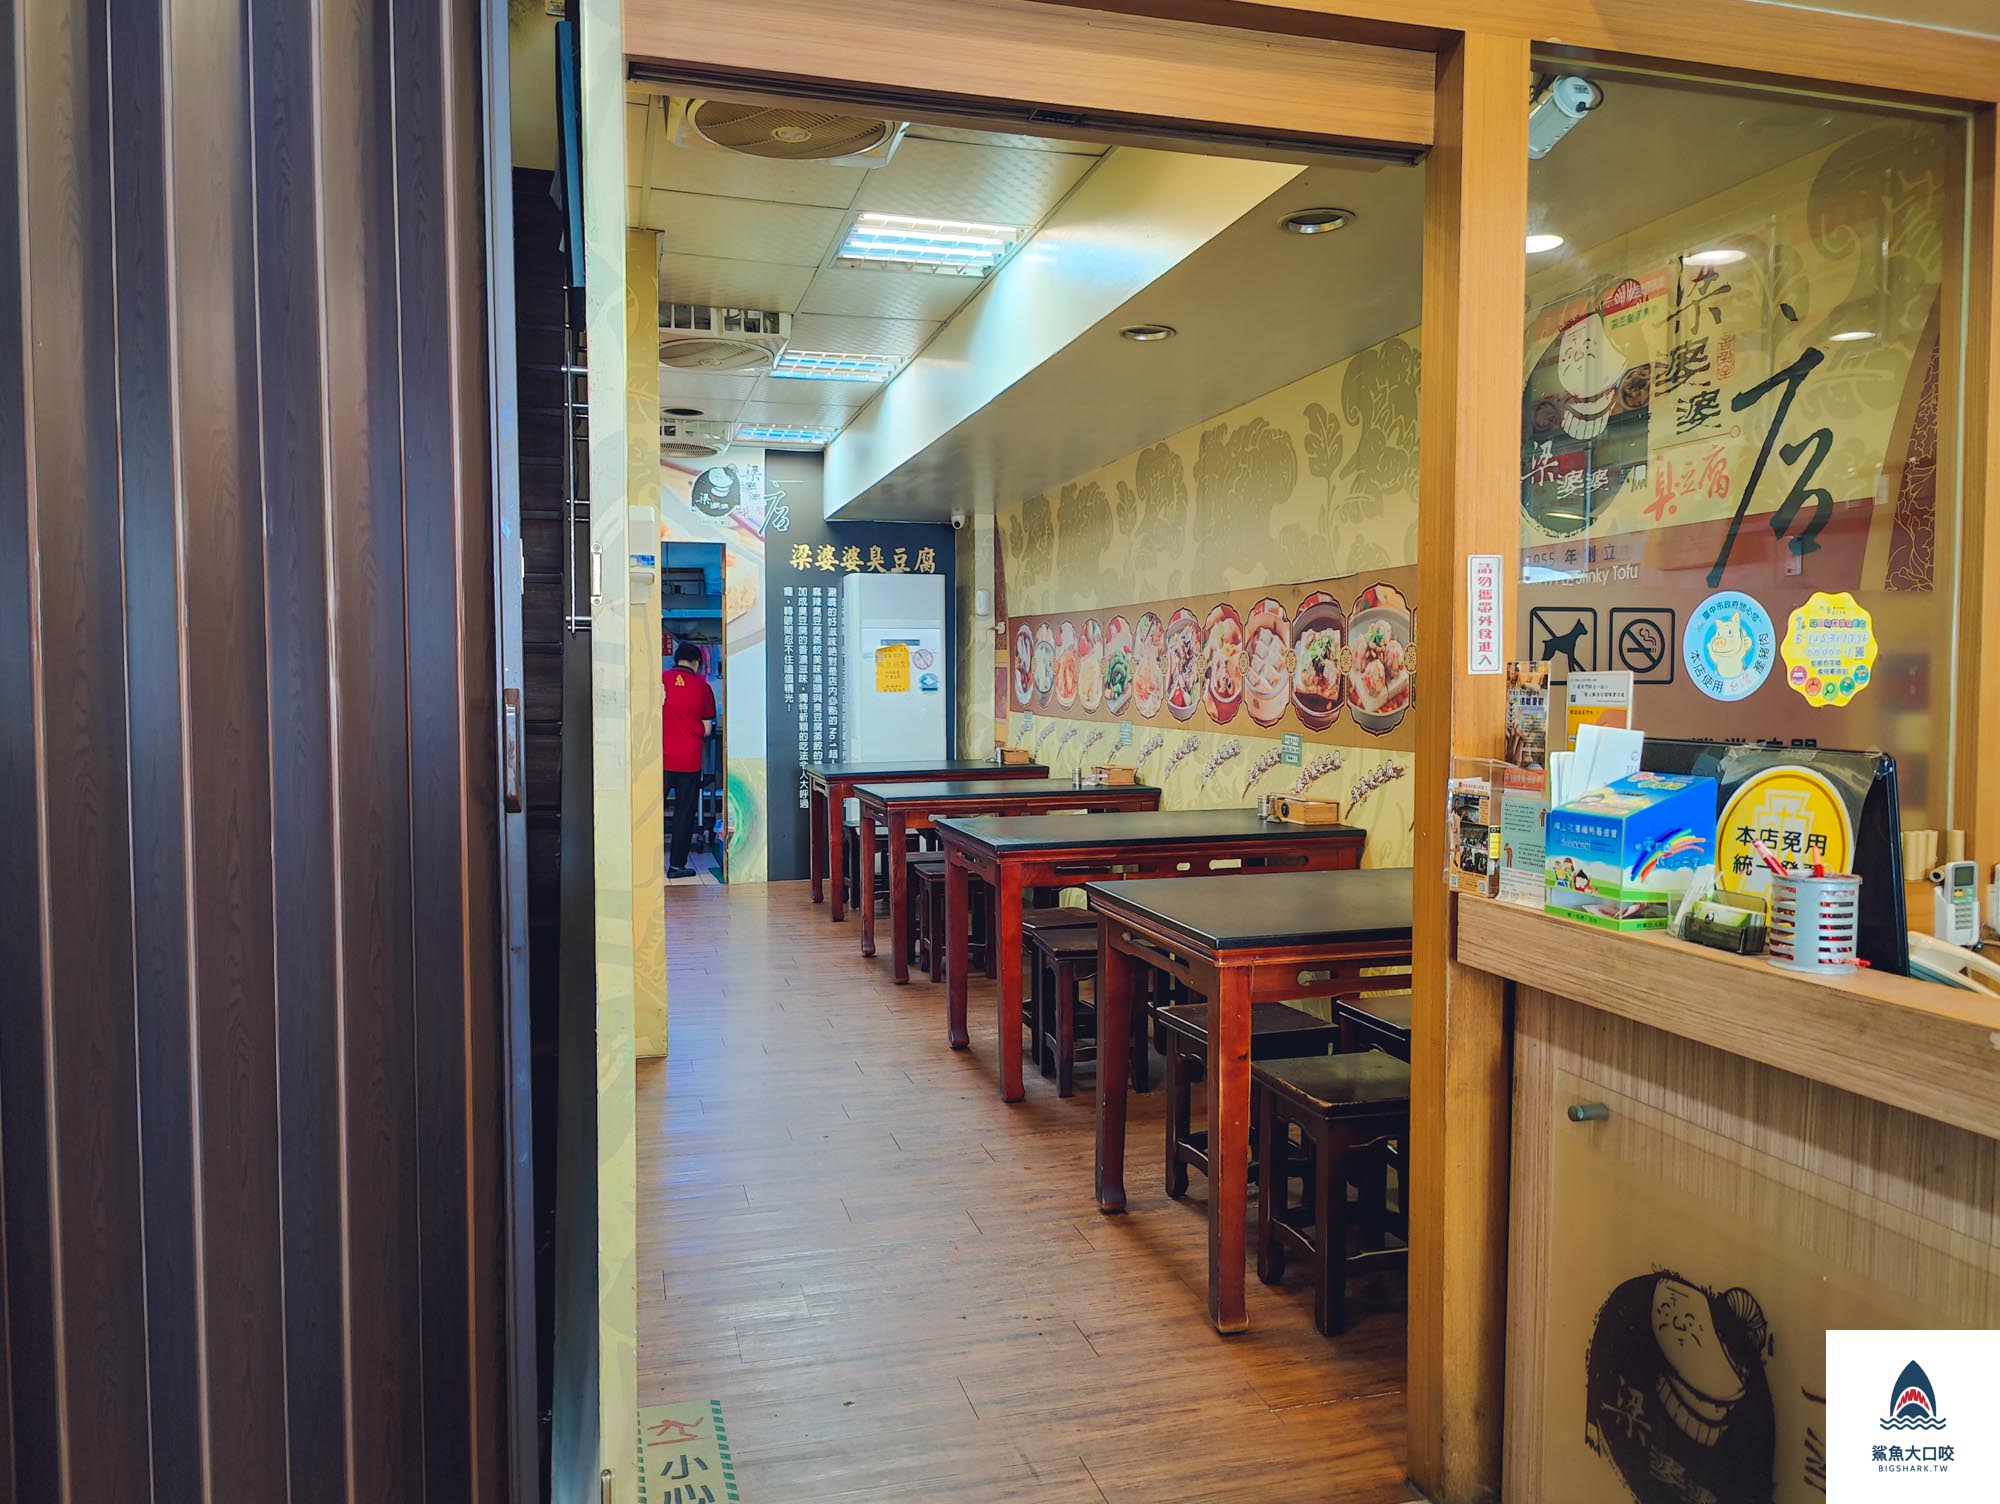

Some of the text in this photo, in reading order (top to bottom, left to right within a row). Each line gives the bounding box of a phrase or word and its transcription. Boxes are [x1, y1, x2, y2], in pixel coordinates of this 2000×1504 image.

[1520, 440, 1609, 499] 梁婆婆
[789, 543, 936, 574] 梁婆婆臭豆腐
[1612, 562, 1639, 581] Tofu
[1477, 562, 1493, 665] 請勿攜帶外食進入
[1735, 825, 1827, 857] 本店免用
